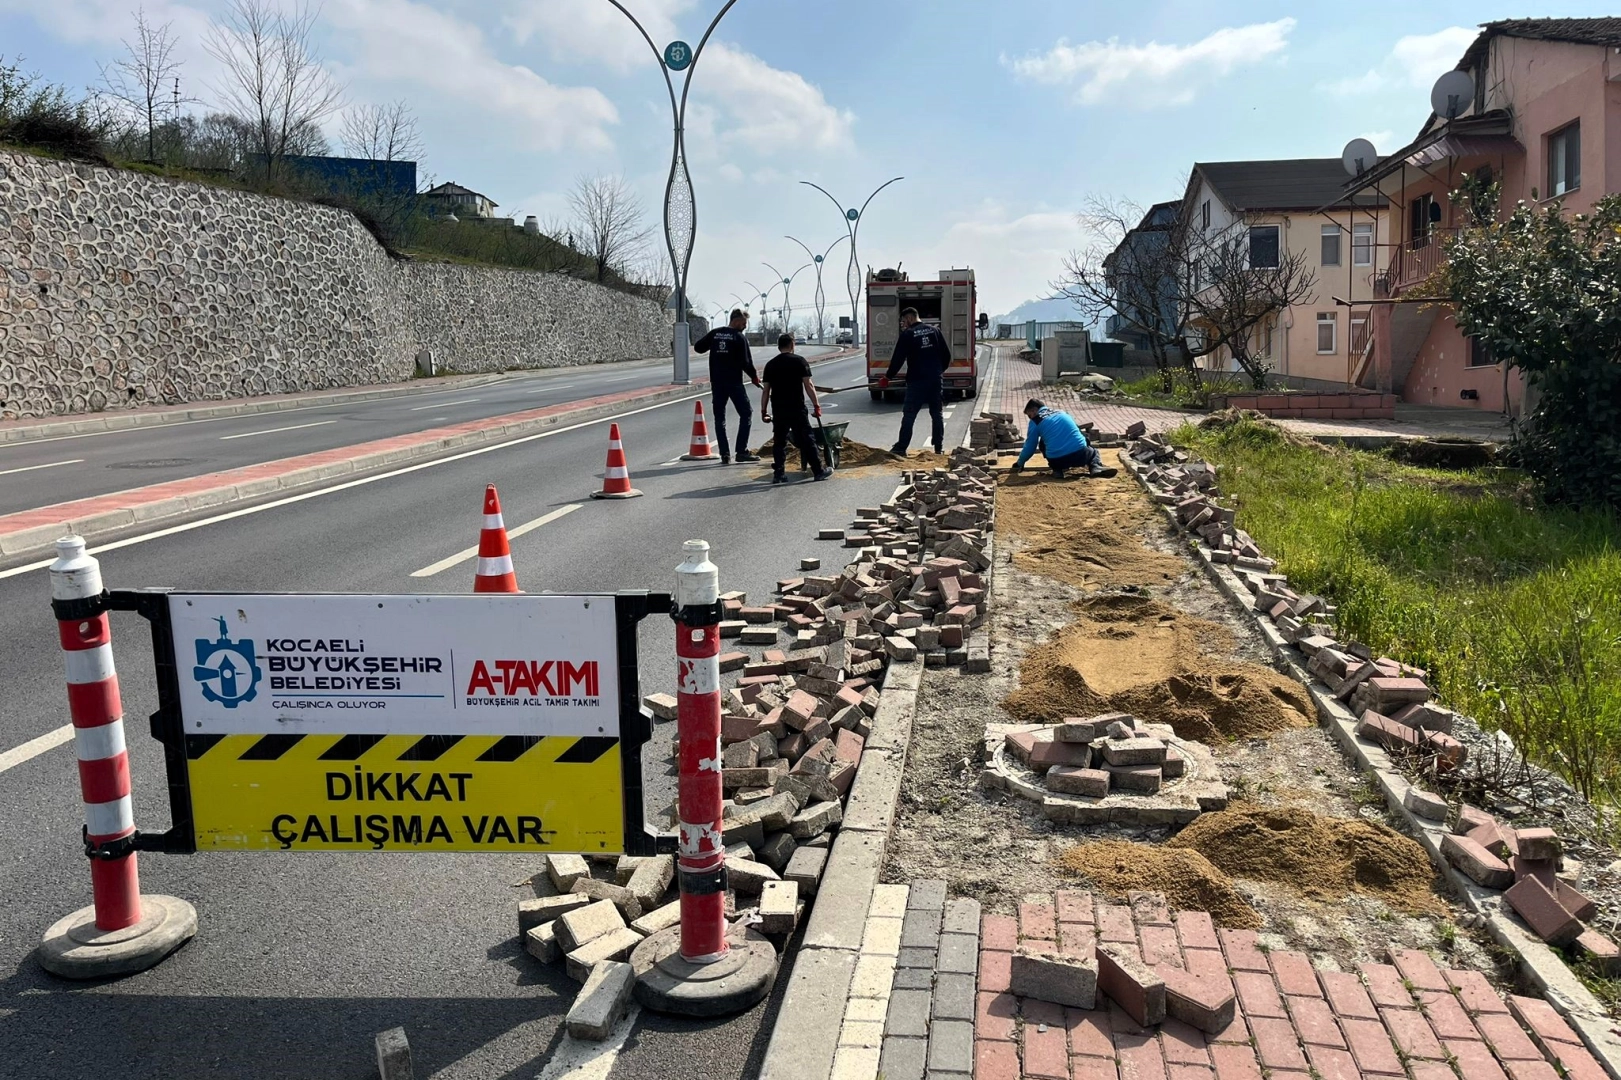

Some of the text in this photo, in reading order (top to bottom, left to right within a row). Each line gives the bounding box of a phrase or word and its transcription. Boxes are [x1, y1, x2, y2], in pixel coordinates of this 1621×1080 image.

[466, 660, 599, 696] A-TAKIMI
[272, 700, 386, 710] ÇALIŞINCA OLUYOR
[573, 698, 600, 706] TAKIMI
[325, 764, 473, 802] DİKKAT
[271, 814, 546, 850] ÇALIŞMA VAR
